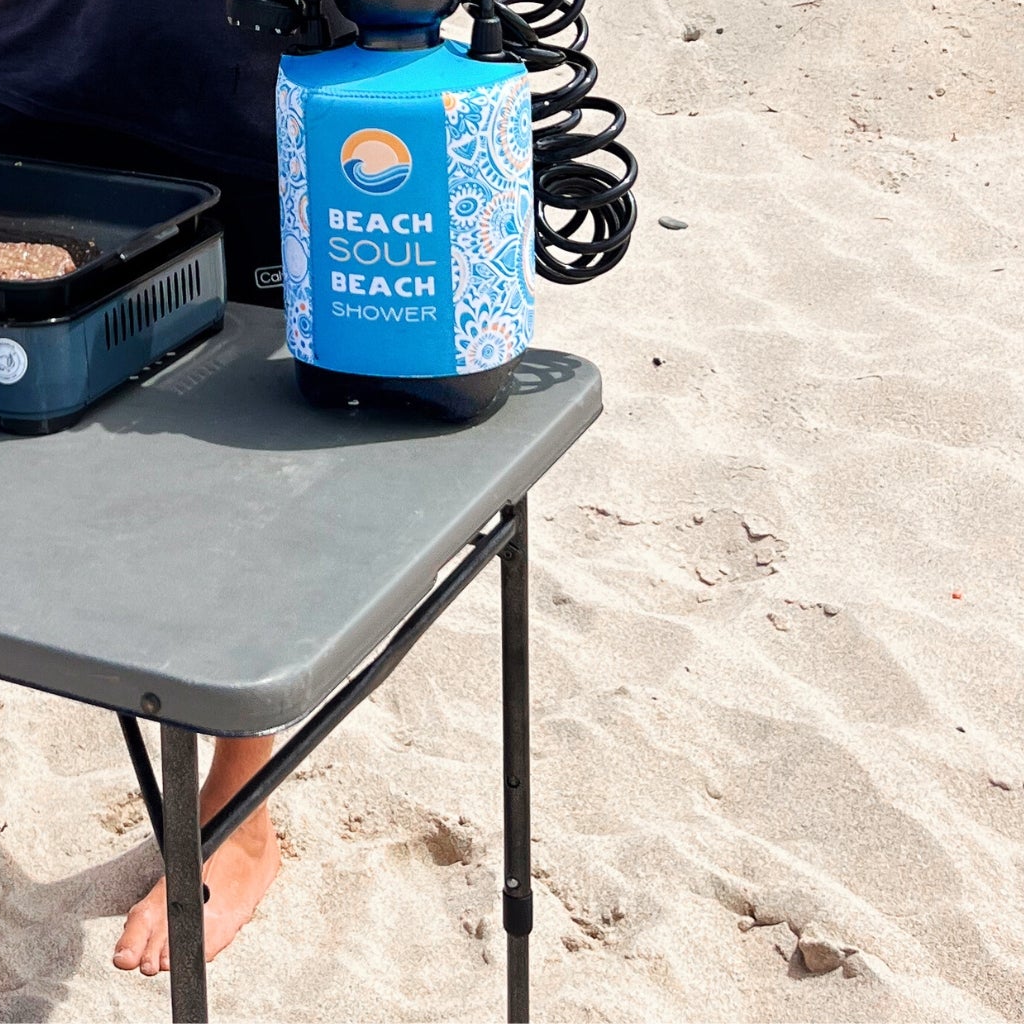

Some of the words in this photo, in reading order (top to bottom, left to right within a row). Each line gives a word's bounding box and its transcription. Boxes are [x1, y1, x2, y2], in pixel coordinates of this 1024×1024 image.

[328, 207, 433, 235] BEACH
[328, 236, 437, 267] SOUL
[260, 270, 283, 284] Cal
[331, 270, 436, 298] BEACH
[331, 301, 437, 323] SHOWER
